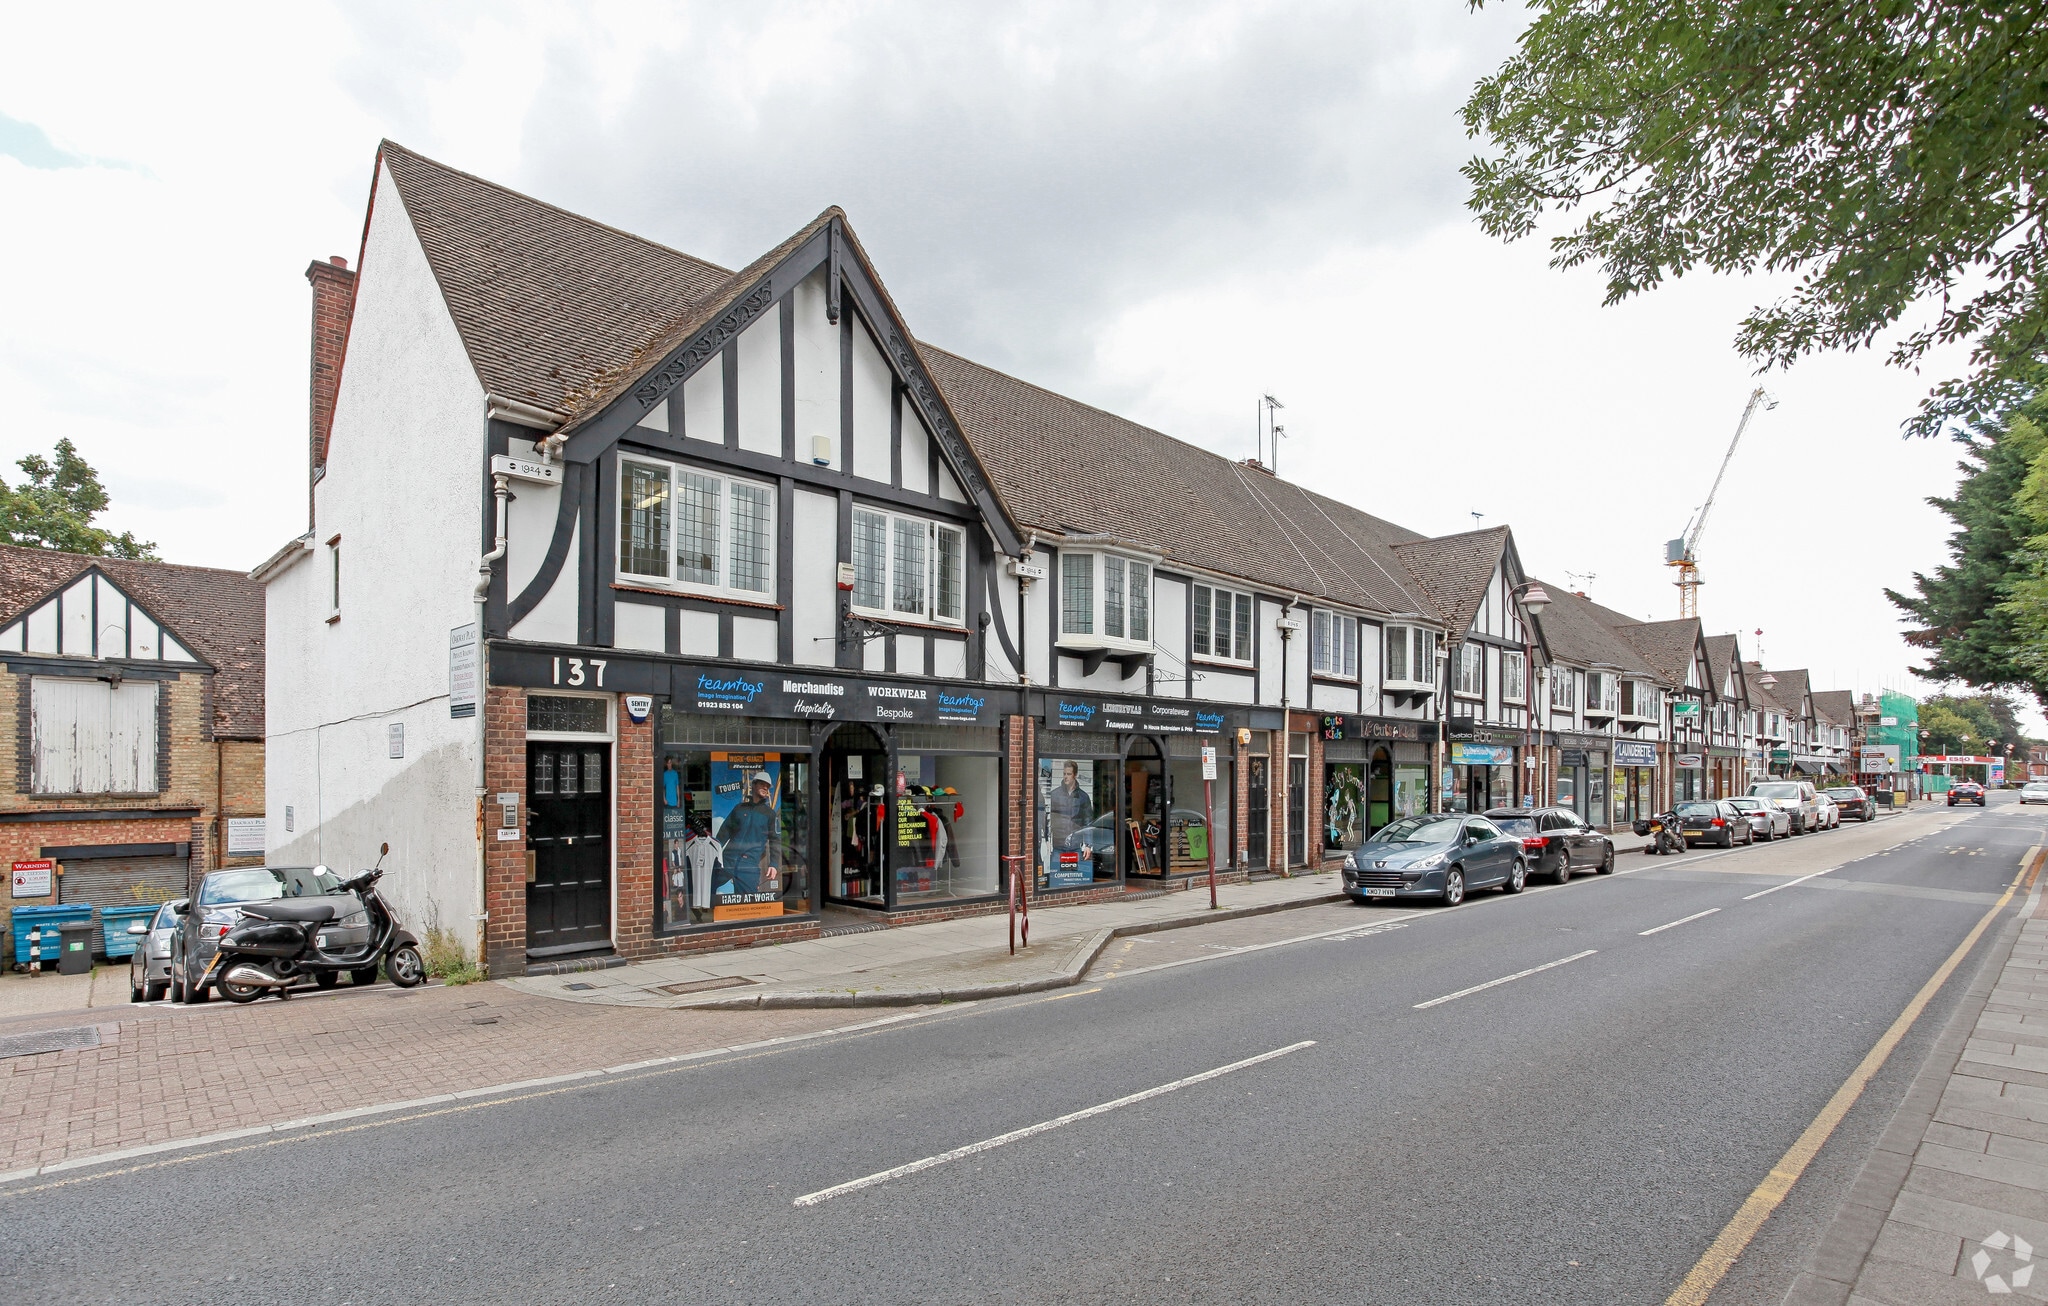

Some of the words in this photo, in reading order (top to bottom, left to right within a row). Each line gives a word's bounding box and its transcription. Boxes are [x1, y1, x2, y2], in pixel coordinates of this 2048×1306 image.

[521, 465, 541, 476] 1924
[553, 657, 607, 687] 137
[697, 673, 764, 702] teamtogs
[783, 680, 844, 696] Merchandise
[868, 686, 927, 700] WORKWEAR
[794, 699, 835, 719] Hospitality
[938, 691, 985, 715] teamtogs
[876, 705, 913, 719] Bespoke
[1059, 701, 1096, 721] teamtogs
[1152, 705, 1190, 716] Corporatewear
[1196, 711, 1224, 728] teamtogs
[1324, 715, 1343, 726] Cuts
[1325, 728, 1343, 740] Kids
[1373, 723, 1392, 737] Cuts
[1619, 744, 1651, 757] LAUNDERETTE
[719, 782, 740, 793] TOUGH
[722, 894, 742, 904] HARD
[744, 893, 753, 903] AT
[754, 892, 776, 902] WORK
